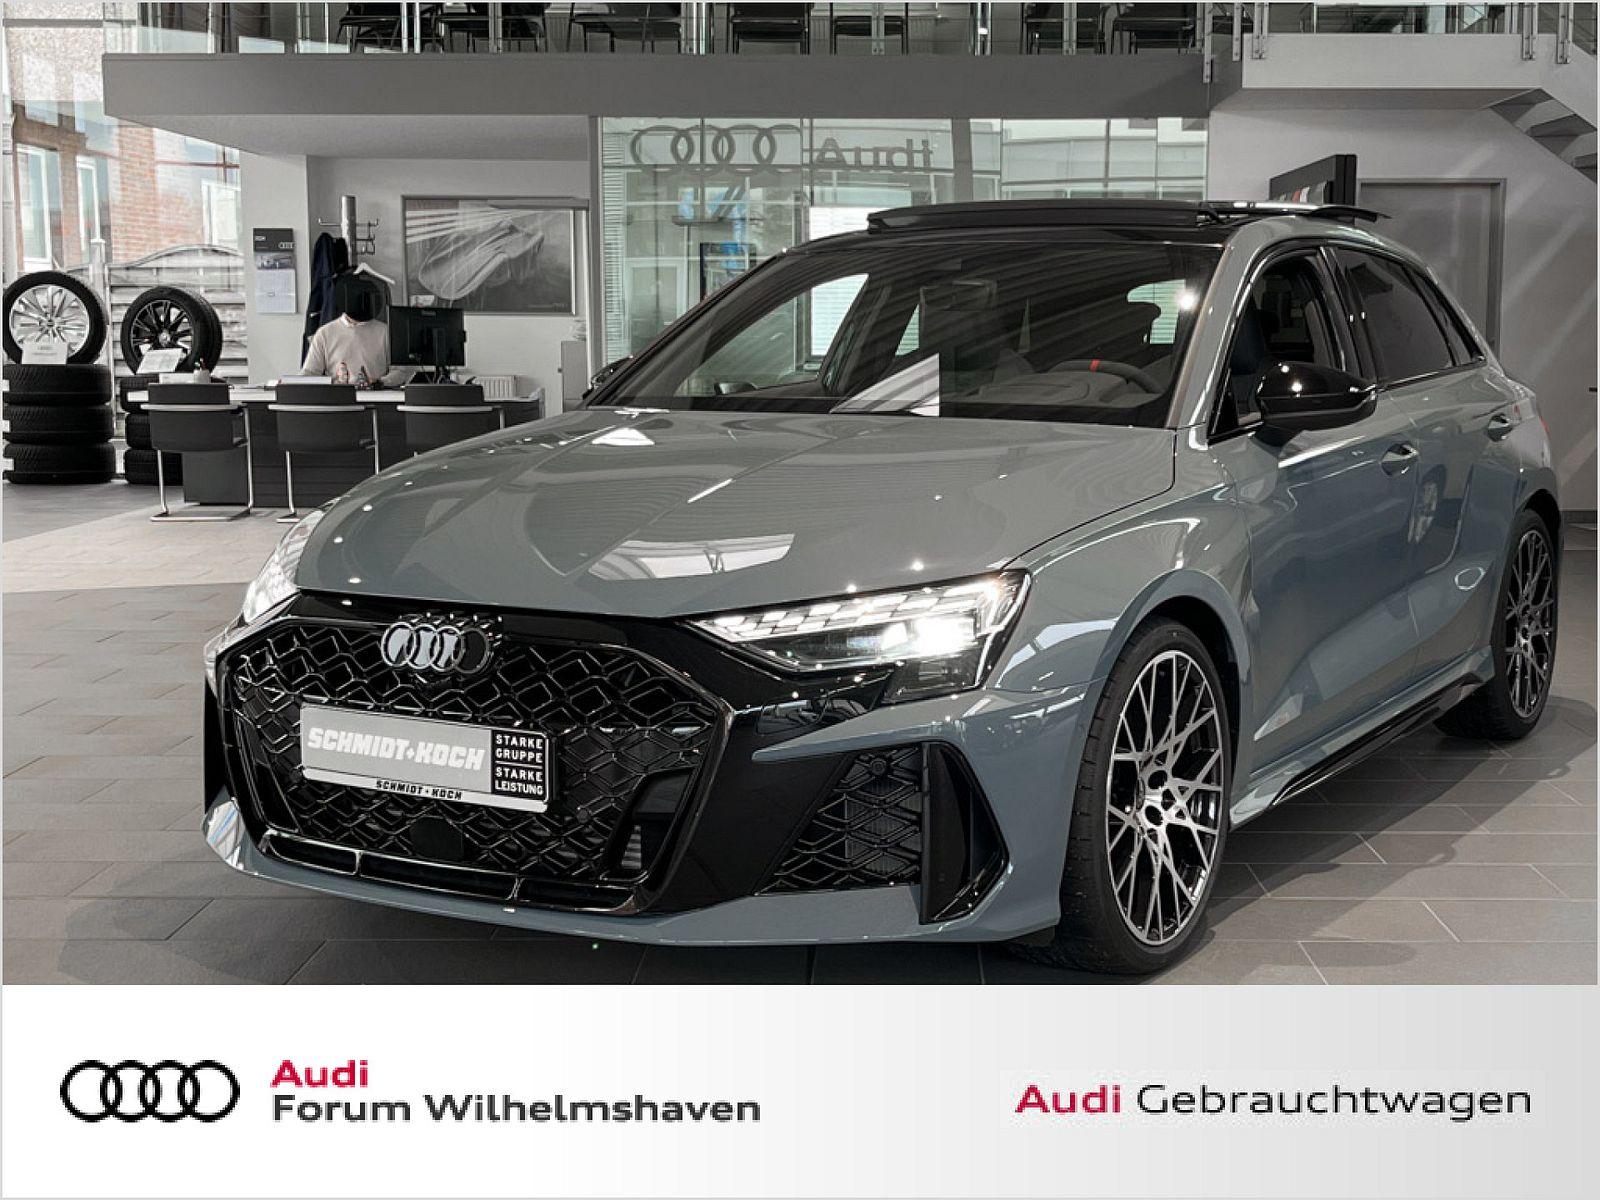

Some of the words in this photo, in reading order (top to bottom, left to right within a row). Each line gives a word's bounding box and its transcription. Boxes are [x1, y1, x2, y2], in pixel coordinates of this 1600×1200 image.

[495, 733, 543, 749] STARKE
[495, 747, 543, 763] GRUPPE
[495, 766, 543, 782] STARKE
[376, 780, 423, 795] SCHMIDT
[431, 788, 462, 801] KOCH
[494, 779, 543, 796] LEISTUNG
